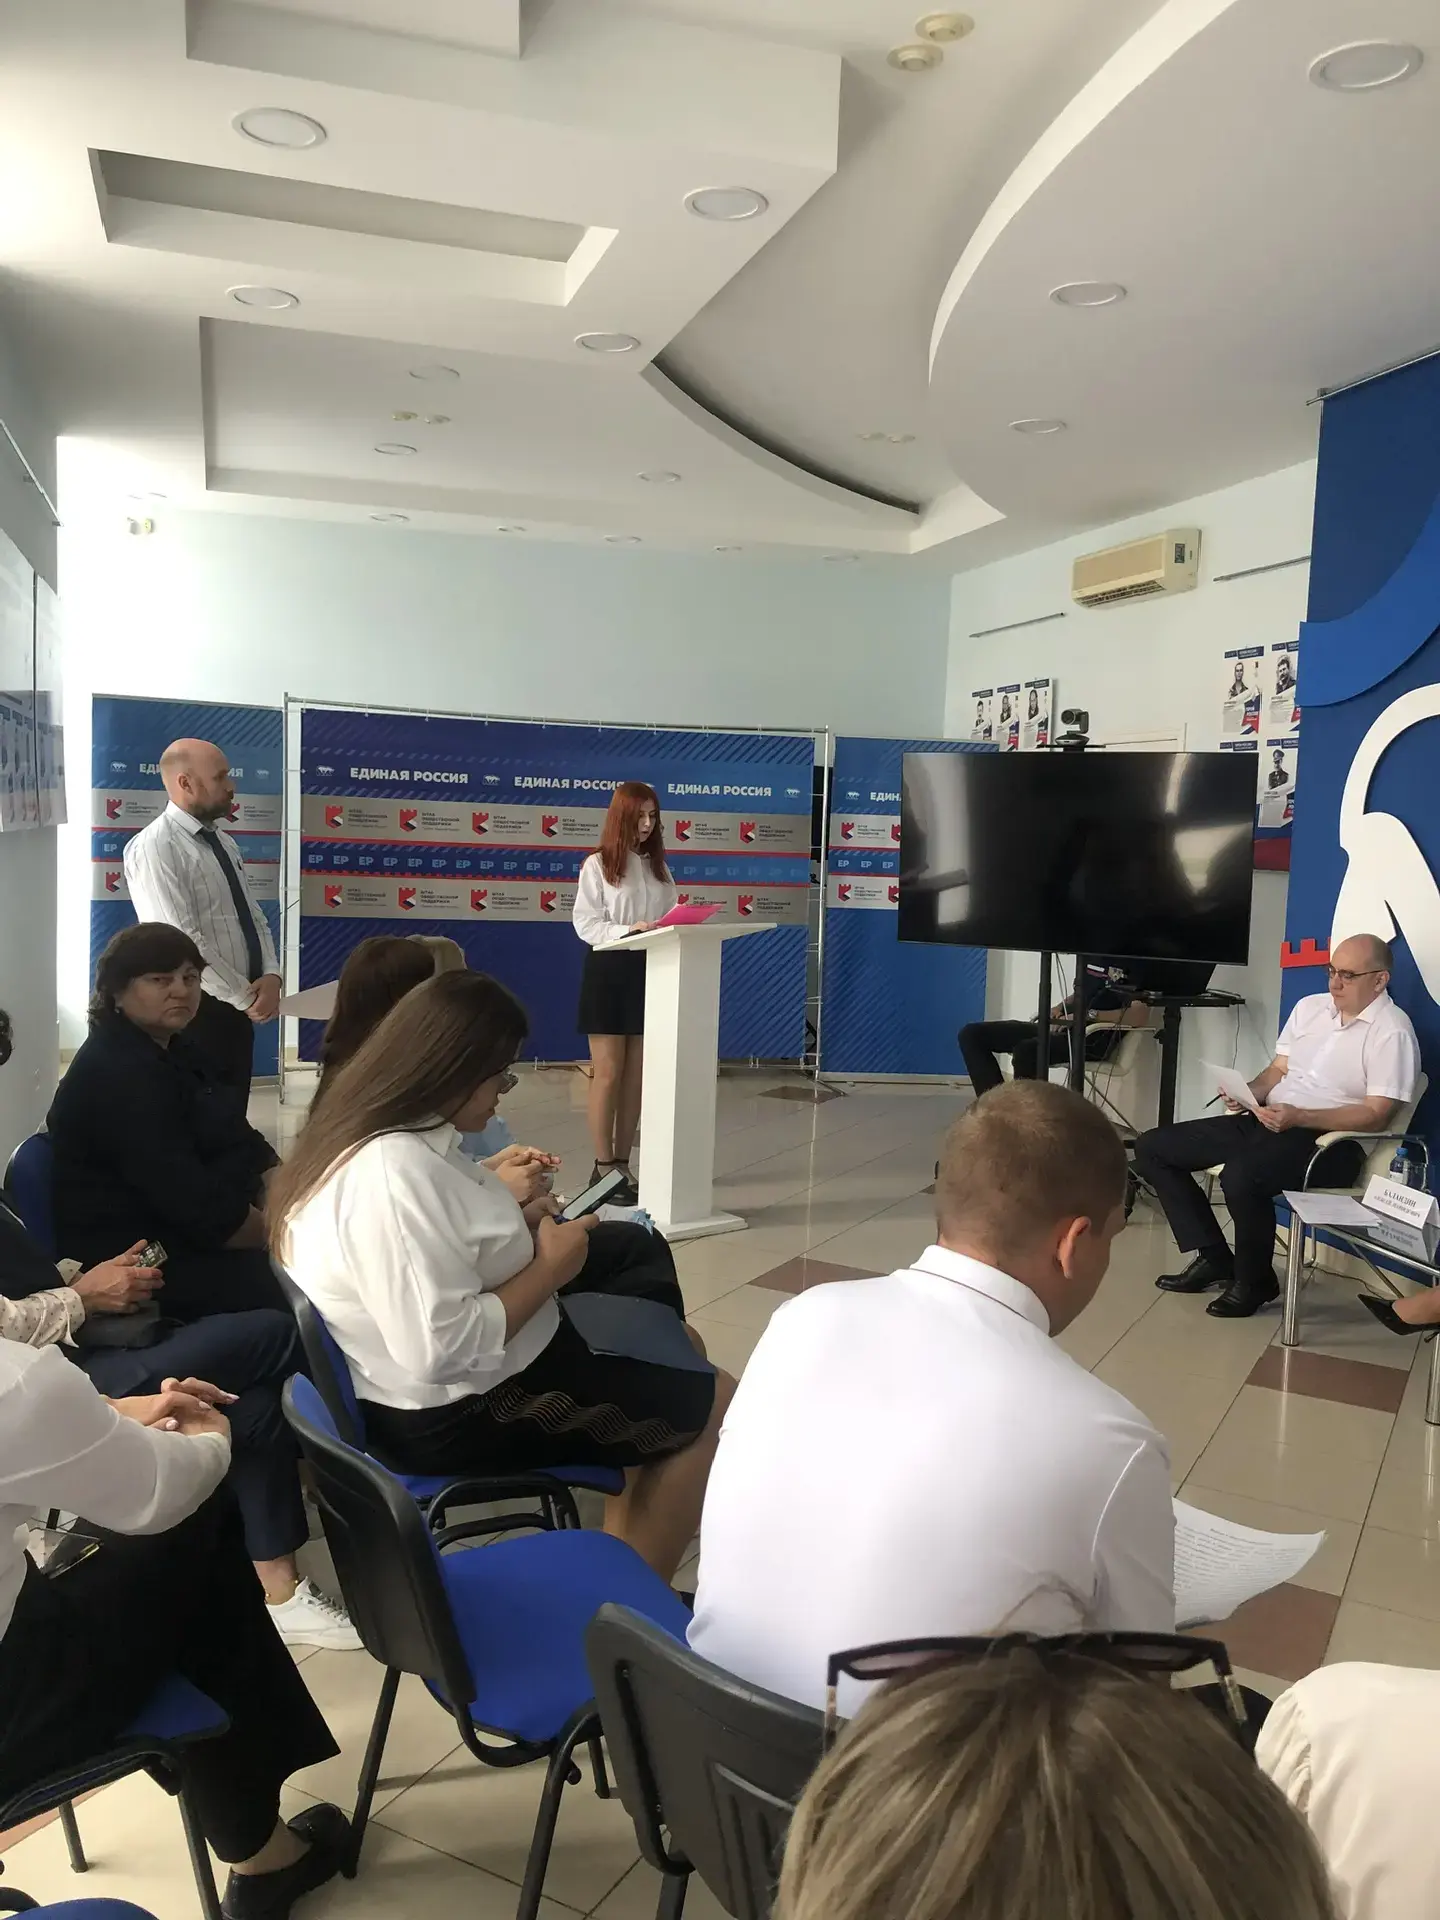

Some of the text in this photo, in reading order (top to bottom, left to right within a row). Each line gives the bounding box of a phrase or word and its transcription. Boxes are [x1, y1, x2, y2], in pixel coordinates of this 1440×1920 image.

[350, 767, 469, 784] ЕДИНАЯ РОССИЯ
[514, 776, 570, 789] ЕДИНАЯ
[667, 783, 772, 797] ЕДИНАЯ РОССИЯ
[870, 792, 901, 802] ЕДИН
[308, 854, 324, 864] ЕР
[333, 855, 349, 865] ЕР
[358, 856, 374, 866] ЕР
[383, 857, 398, 867] ЕР
[408, 858, 423, 868] ЕР
[431, 859, 447, 868] ЕР
[455, 859, 471, 869] ЕР
[480, 860, 494, 870] ЕР
[503, 861, 517, 870] ЕР
[526, 862, 541, 871] ЕР
[550, 863, 564, 872] ЕР
[838, 860, 850, 868] ЕР
[882, 861, 894, 869] ЕР
